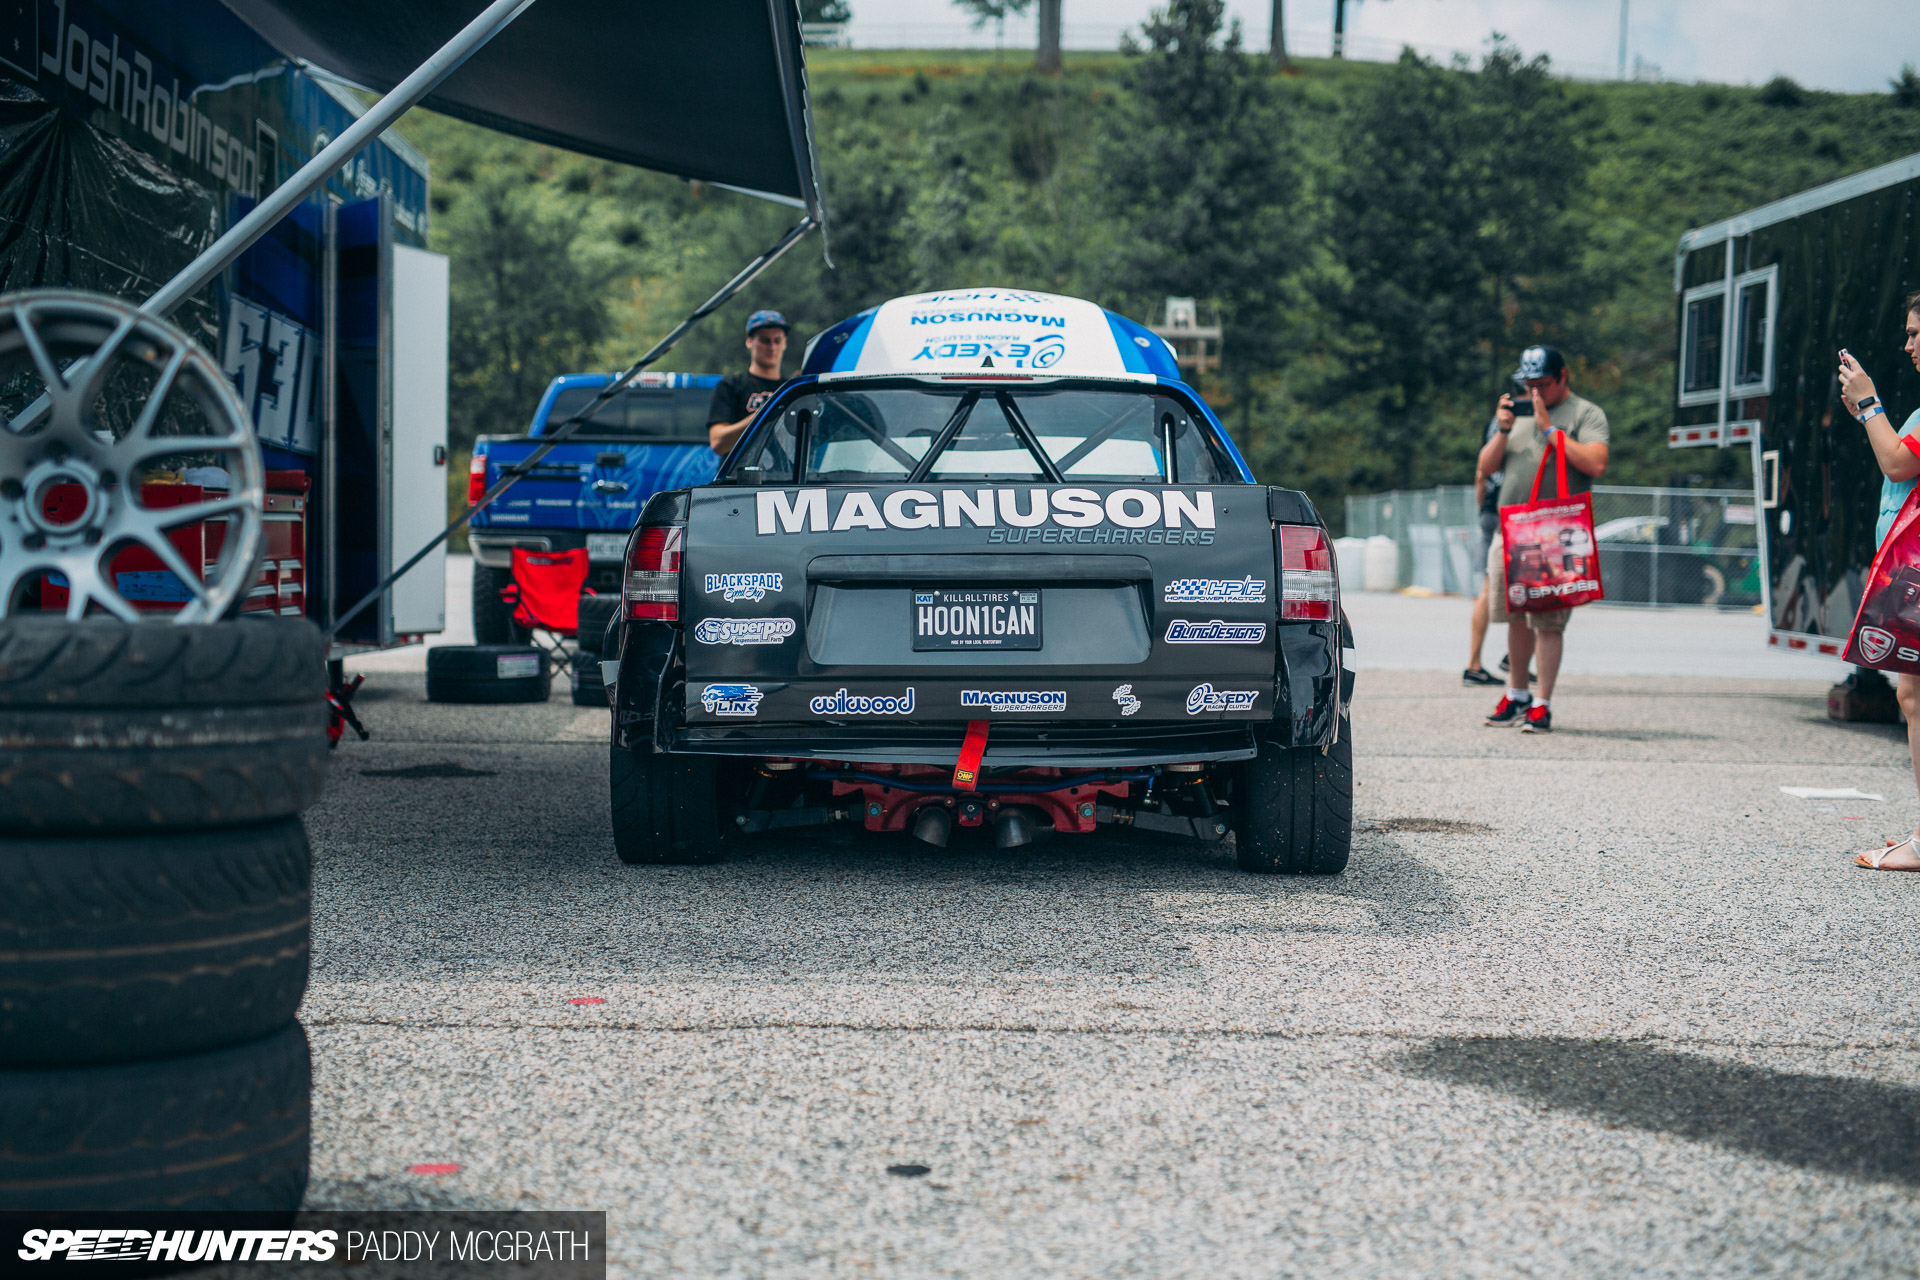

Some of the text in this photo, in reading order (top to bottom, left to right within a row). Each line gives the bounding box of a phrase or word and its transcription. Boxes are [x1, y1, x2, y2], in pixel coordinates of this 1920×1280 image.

[911, 312, 1066, 328] MAGNUSON
[911, 343, 1031, 361] EXEDY
[756, 488, 1217, 536] MAGNUSON
[988, 528, 1216, 546] SUPERCHARGERS
[705, 574, 782, 592] BLACKSPADE
[916, 595, 933, 603] KAT
[943, 593, 1009, 603] KILL ALL TIRES
[918, 605, 1035, 636] HOON1GAN
[812, 688, 914, 713] wilwood
[962, 691, 1065, 704] MAGNUSON
[1203, 693, 1257, 704] EXEDY
